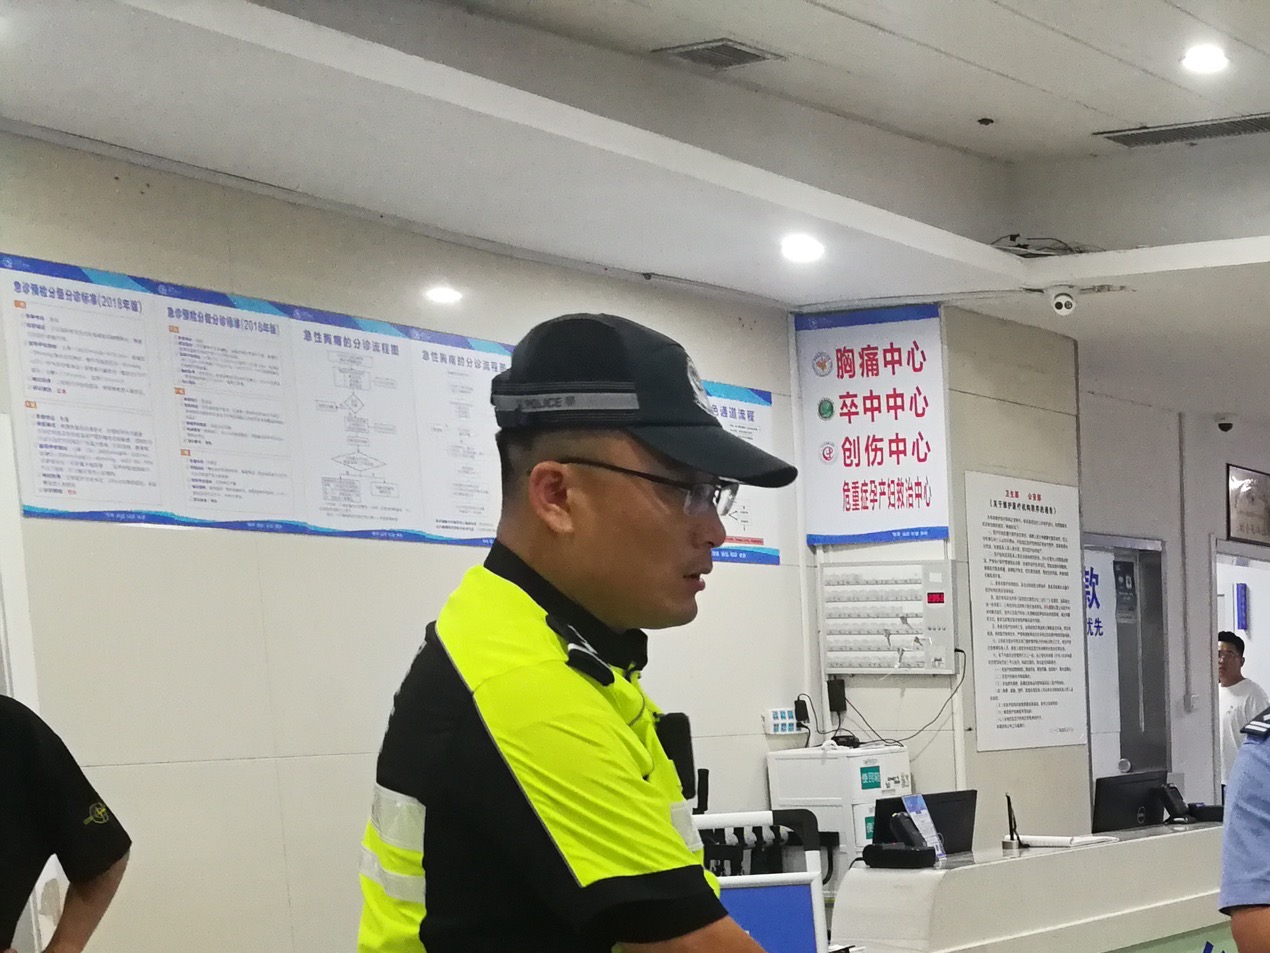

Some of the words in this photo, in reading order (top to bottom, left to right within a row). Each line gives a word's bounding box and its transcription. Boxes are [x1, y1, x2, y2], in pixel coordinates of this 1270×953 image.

[835, 340, 927, 380] 胸痛中心
[838, 386, 930, 424] 卒中中心
[840, 431, 932, 468] 创伤中心
[842, 475, 932, 512] 危重症孕产妇救治中心
